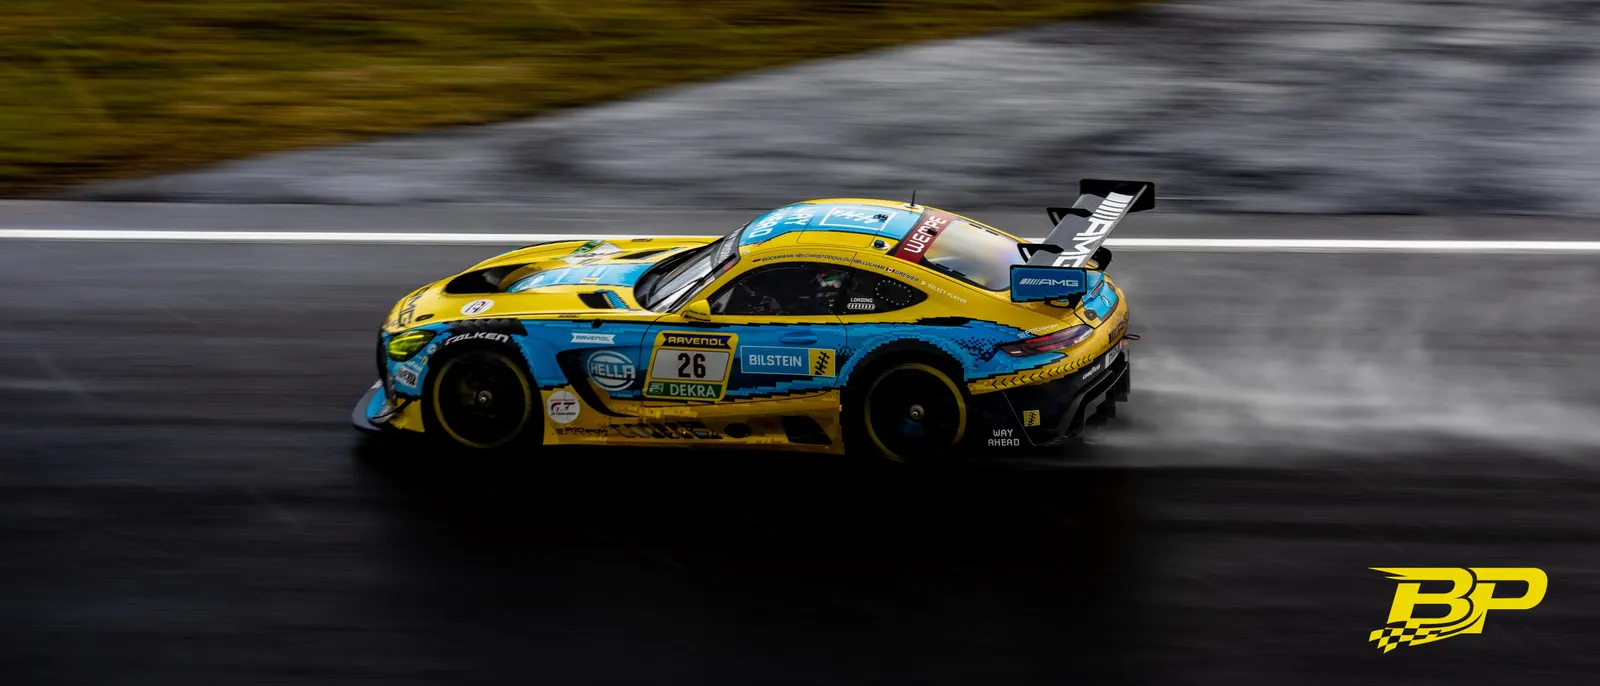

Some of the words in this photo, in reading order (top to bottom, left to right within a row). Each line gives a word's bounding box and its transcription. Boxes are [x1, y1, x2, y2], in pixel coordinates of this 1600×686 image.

[904, 215, 948, 254] WEMPE
[445, 331, 510, 346] FALKEN
[575, 334, 611, 342] RAVENOL
[668, 335, 726, 347] RAVENOL
[677, 352, 706, 379] 26
[748, 354, 802, 367] BILSTEIN
[591, 362, 636, 379] HELLA
[669, 383, 717, 398] DEKRA
[992, 428, 1014, 437] WAY
[987, 438, 1020, 447] AHEAD
